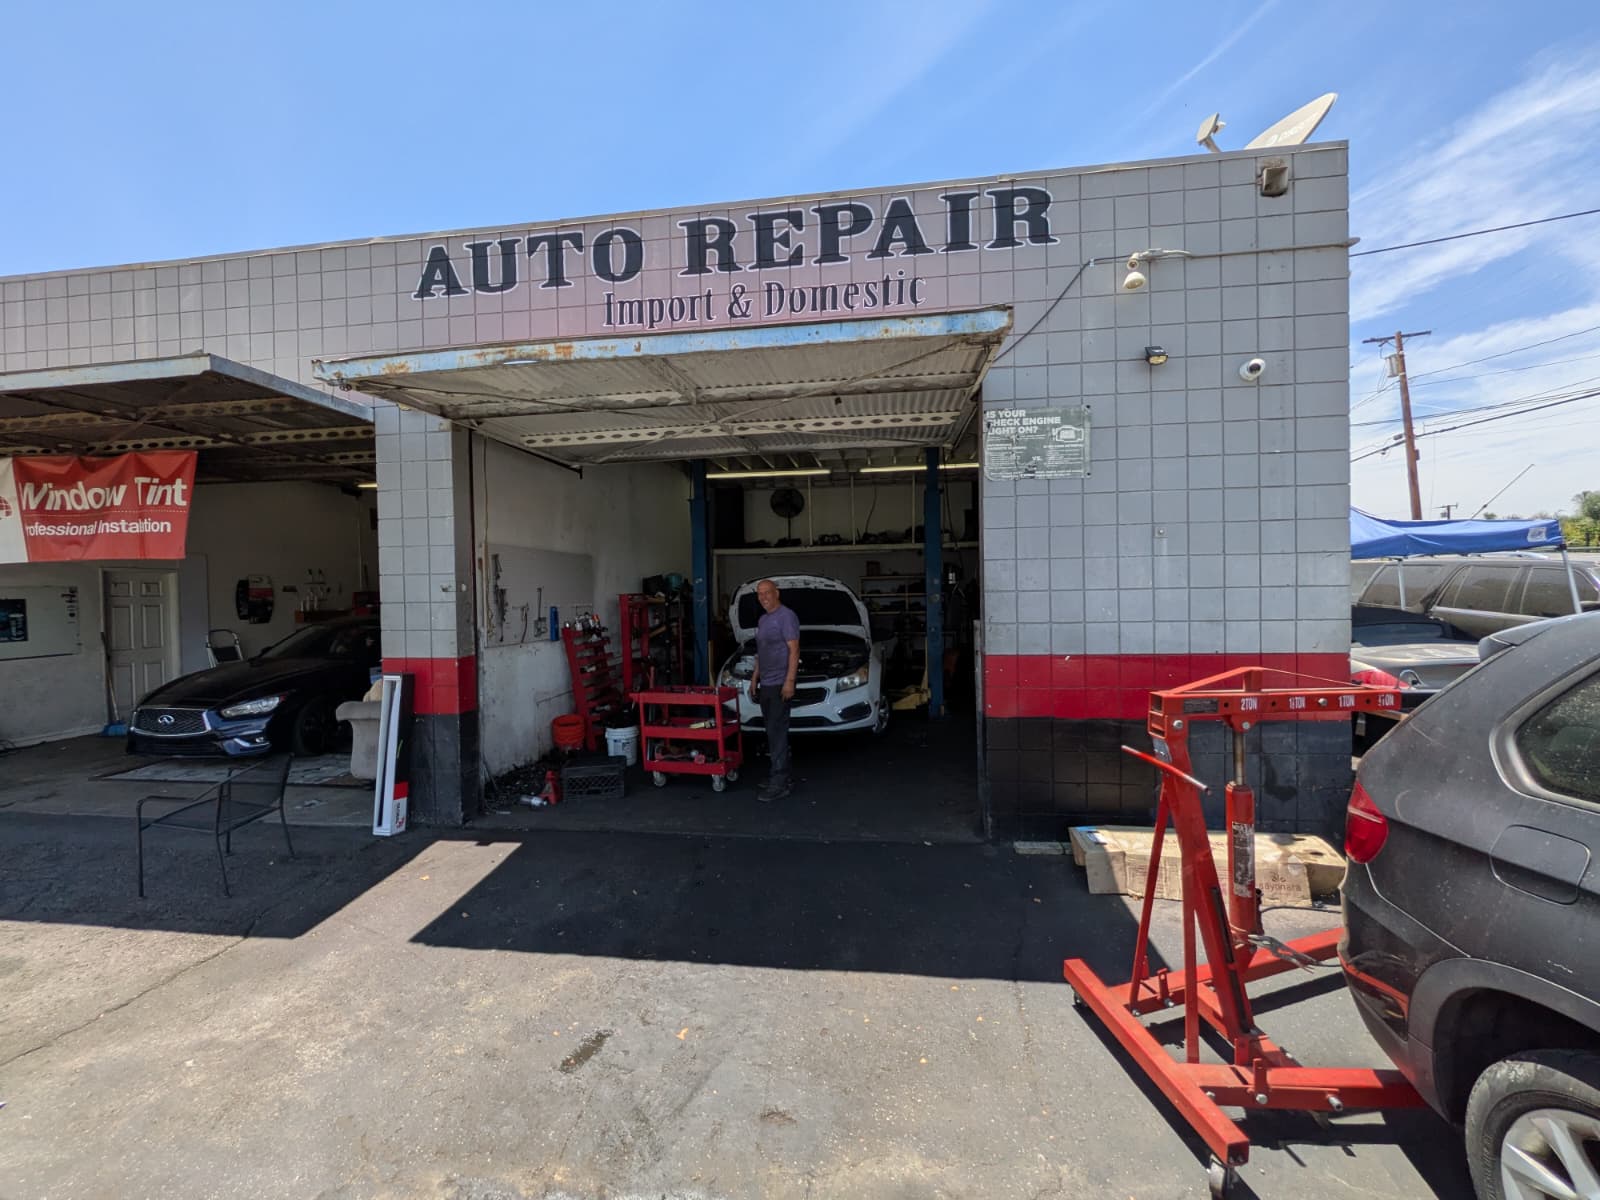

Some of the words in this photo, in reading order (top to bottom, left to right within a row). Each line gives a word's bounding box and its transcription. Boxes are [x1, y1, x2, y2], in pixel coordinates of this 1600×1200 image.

[414, 227, 643, 299] AUTO
[677, 186, 1058, 277] REPAIR
[603, 288, 714, 328] Import
[727, 284, 753, 318] &
[764, 269, 926, 316] Domestic
[986, 410, 996, 418] IS
[998, 409, 1026, 418] YOUR
[1022, 416, 1062, 425] ENGINE
[1018, 425, 1039, 434] ON?
[18, 481, 127, 511] Window
[134, 477, 187, 507] Tint
